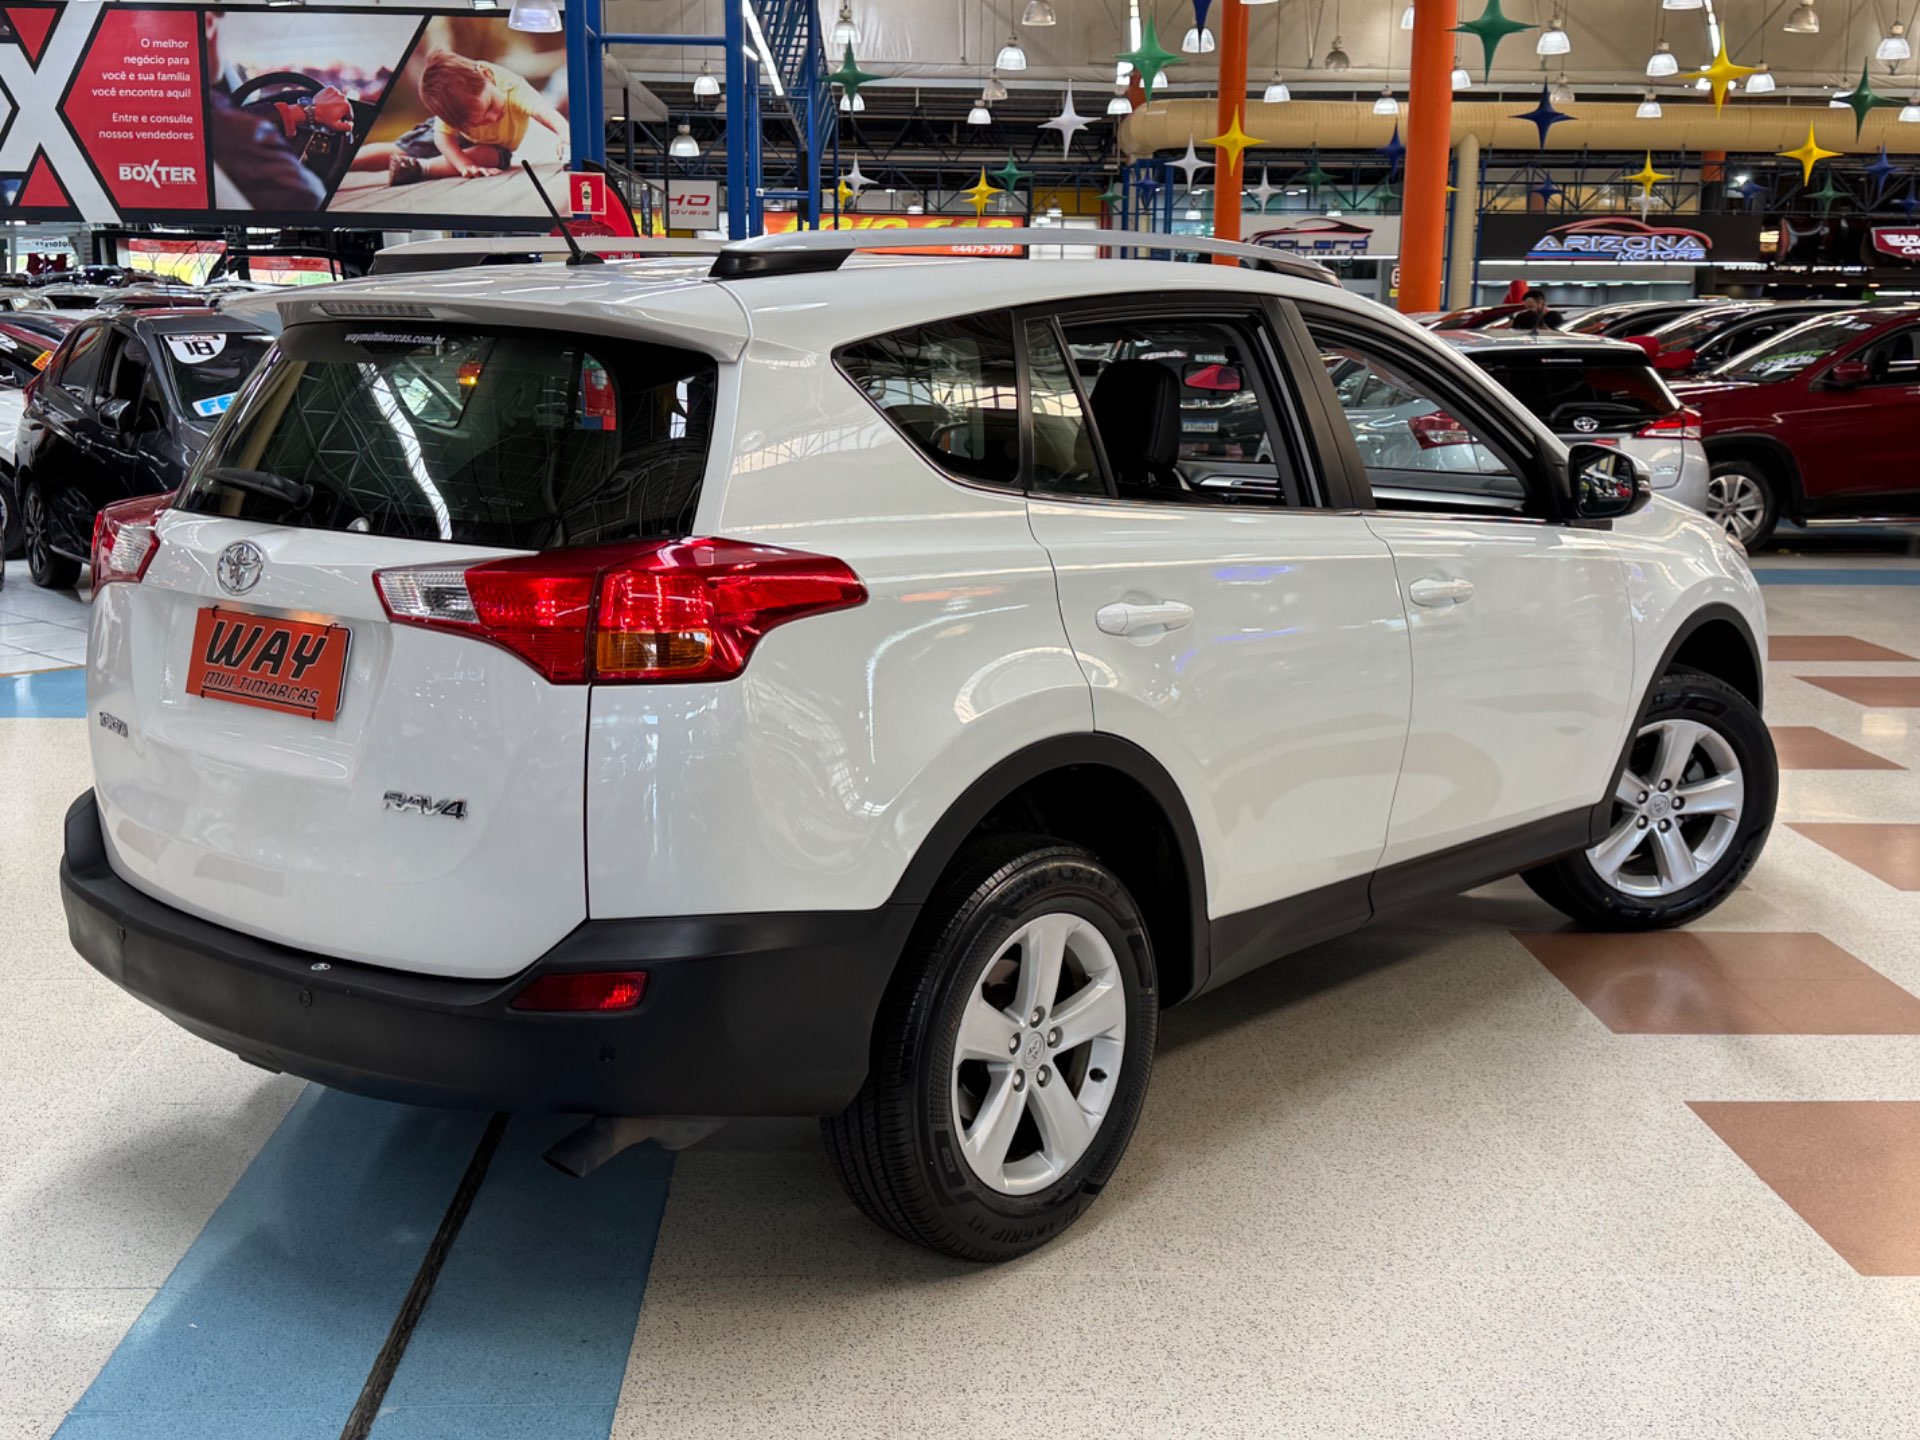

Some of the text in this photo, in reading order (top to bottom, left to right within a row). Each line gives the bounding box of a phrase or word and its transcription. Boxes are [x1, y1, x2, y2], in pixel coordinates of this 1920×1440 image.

[140, 38, 189, 48] O melhor
[124, 54, 189, 67] negócio para
[102, 71, 126, 80] você
[157, 71, 190, 81] família
[92, 87, 191, 99] você encontra aqui!
[112, 112, 193, 123] Entre e consulte
[99, 130, 194, 140] nossos vendedores
[118, 159, 196, 188] BOXTER
[1532, 235, 1706, 251] ARIZONA
[1615, 250, 1706, 260] MOTORS
[344, 331, 446, 345] waymultimarcas.com.br
[204, 619, 329, 681] WAY
[203, 671, 320, 704] MULTIMARCAS
[383, 790, 469, 820] RAV4
